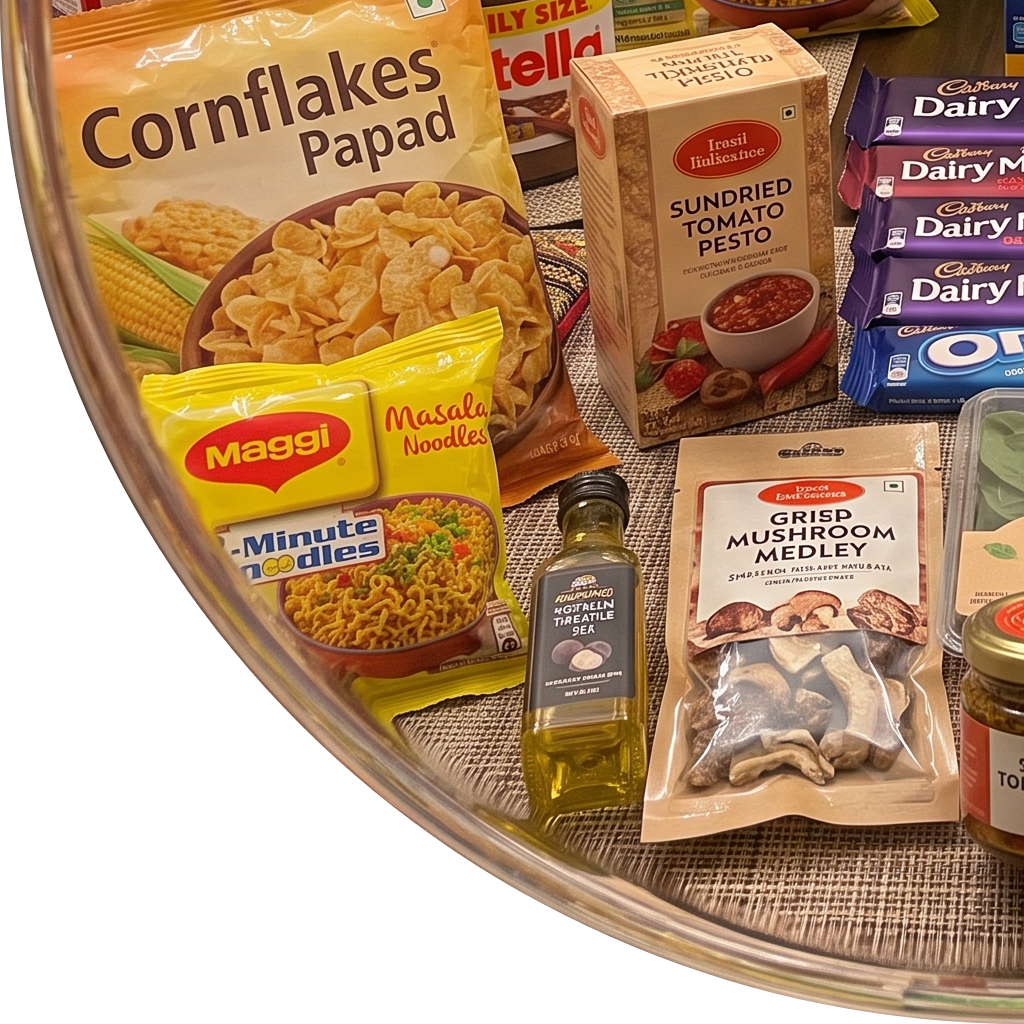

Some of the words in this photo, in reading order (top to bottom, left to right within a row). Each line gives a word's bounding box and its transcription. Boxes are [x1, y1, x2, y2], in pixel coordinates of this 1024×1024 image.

[81, 47, 442, 169] Cornflakes
[913, 96, 1021, 119] Dairy
[299, 95, 456, 176] Papad
[901, 159, 995, 184] Dairy
[670, 178, 792, 219] SUNDRIED
[682, 202, 784, 238] TOMATO
[915, 216, 1012, 239] Dairy
[698, 226, 773, 258] PESTO
[911, 278, 1013, 305] Dairy
[385, 392, 488, 432] Masala
[205, 423, 330, 470] Maggi
[403, 423, 488, 457] Noodles
[770, 508, 853, 525] GRISP
[726, 525, 896, 551] MUSHROOM
[754, 542, 868, 564] MEDLEY
